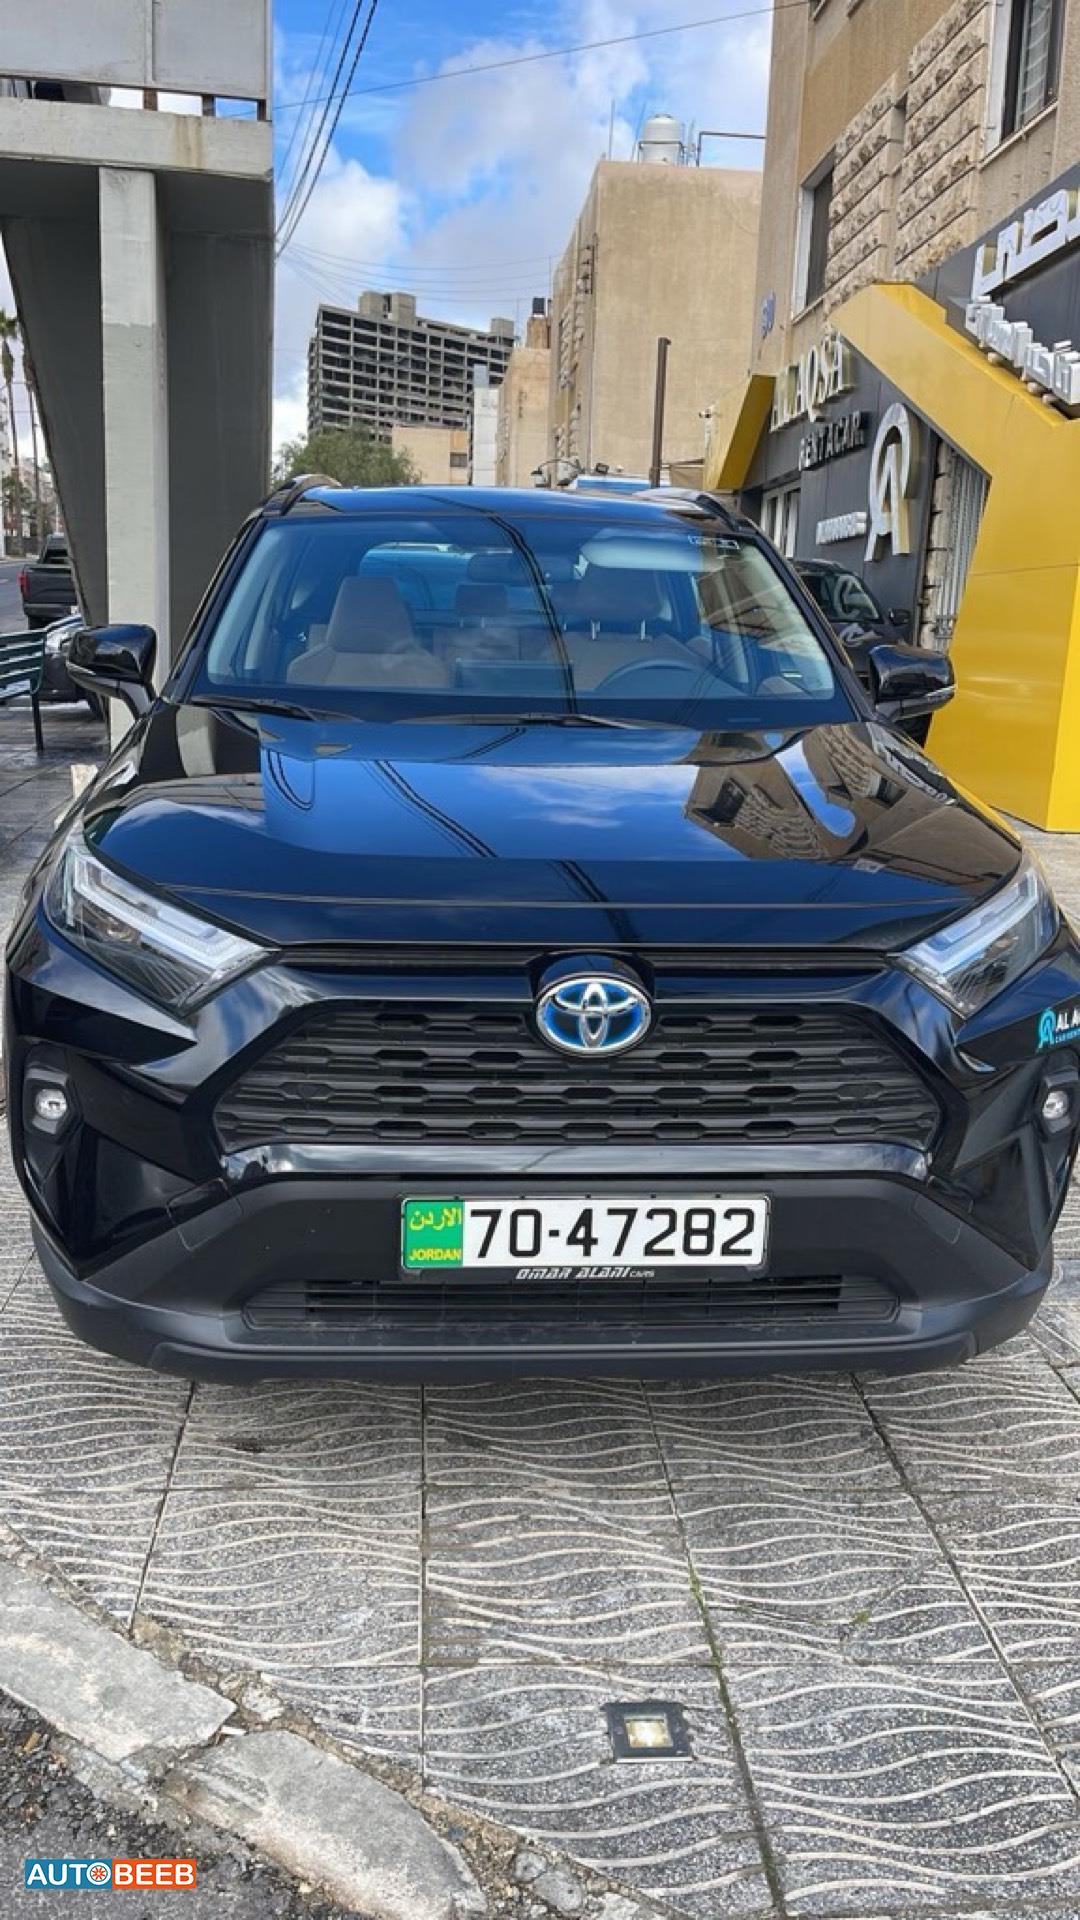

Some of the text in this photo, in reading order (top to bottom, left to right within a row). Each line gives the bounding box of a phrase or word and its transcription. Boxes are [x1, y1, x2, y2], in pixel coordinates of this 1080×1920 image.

[470, 1208, 756, 1258] 70-47282
[409, 1248, 462, 1262] JORDAN
[516, 1268, 573, 1280] OMAR
[575, 1266, 631, 1278] ALANI
